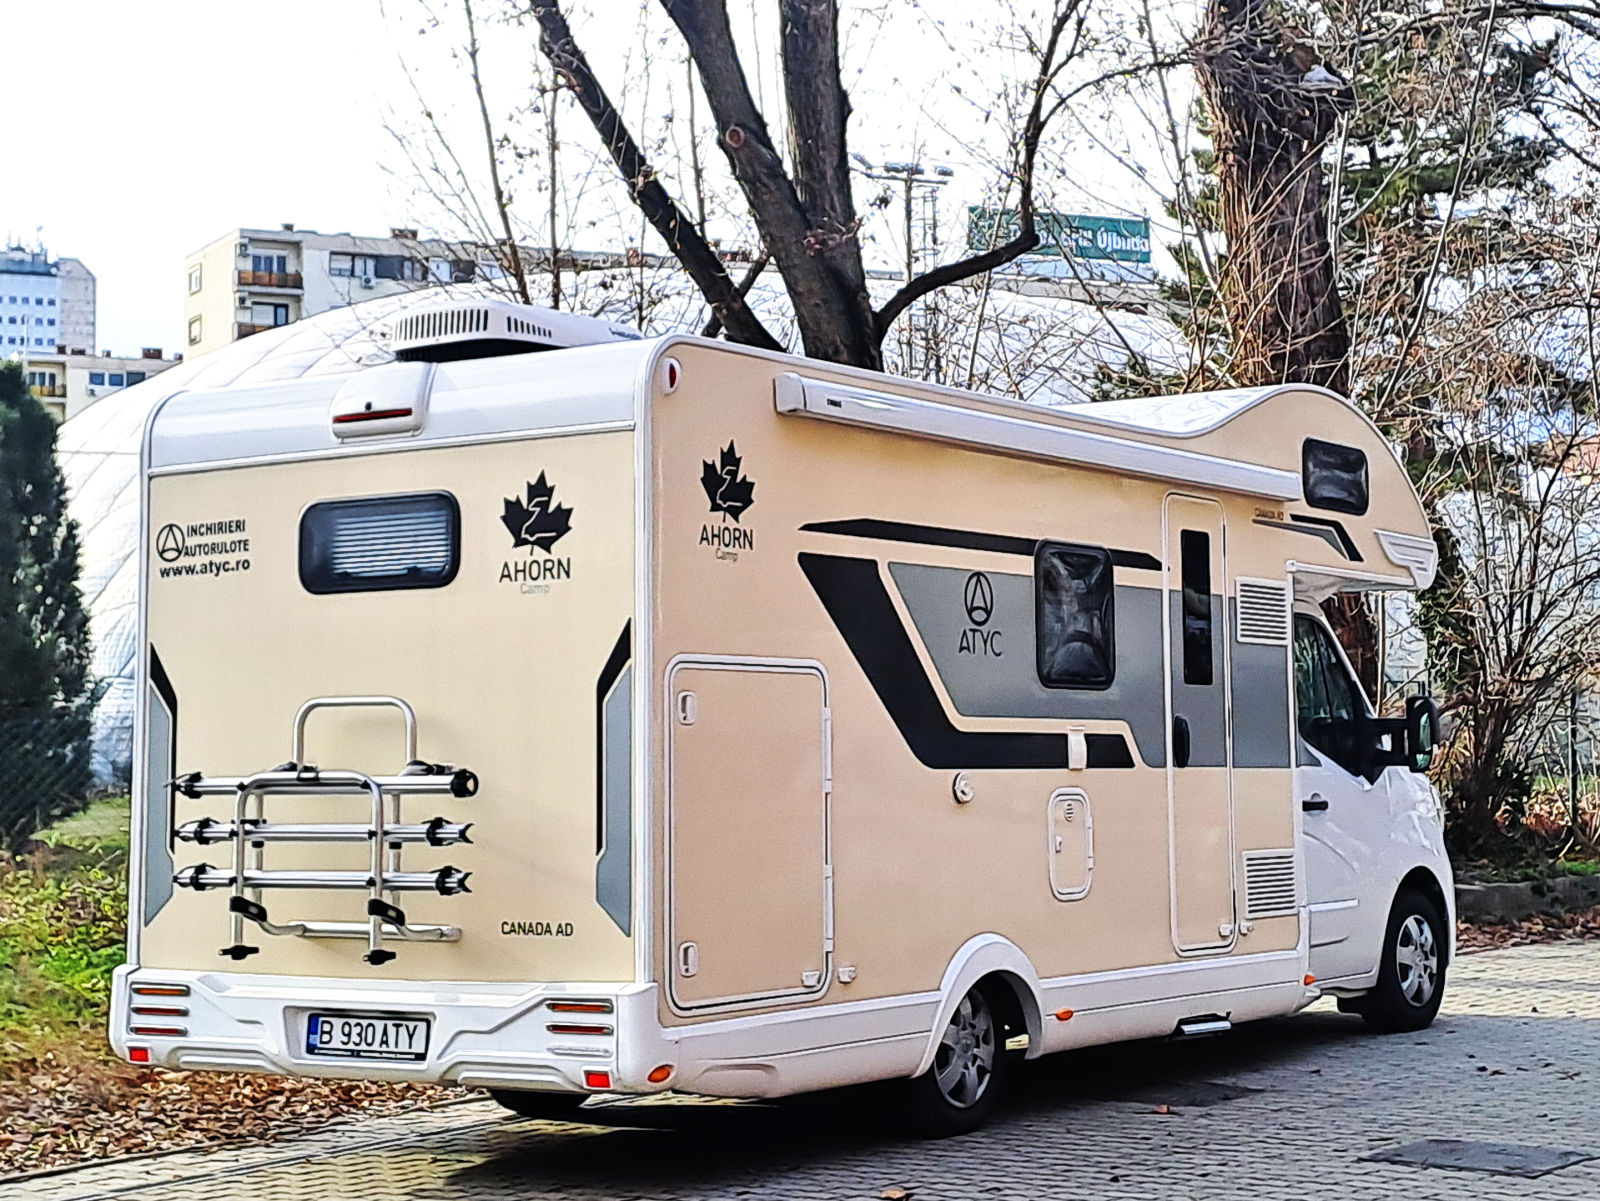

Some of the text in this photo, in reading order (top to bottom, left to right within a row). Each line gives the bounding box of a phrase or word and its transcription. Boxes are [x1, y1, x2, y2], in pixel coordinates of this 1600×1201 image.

[187, 518, 246, 538] INCHIRIERI
[699, 524, 753, 551] AHORN
[183, 539, 250, 557] AUTORULOTE
[160, 559, 250, 578] www.atyc.ro
[499, 557, 571, 583] AHORN
[959, 628, 1002, 657] ATYC
[501, 921, 574, 937] CANADA AD
[319, 1020, 419, 1049] B 930 ATY
